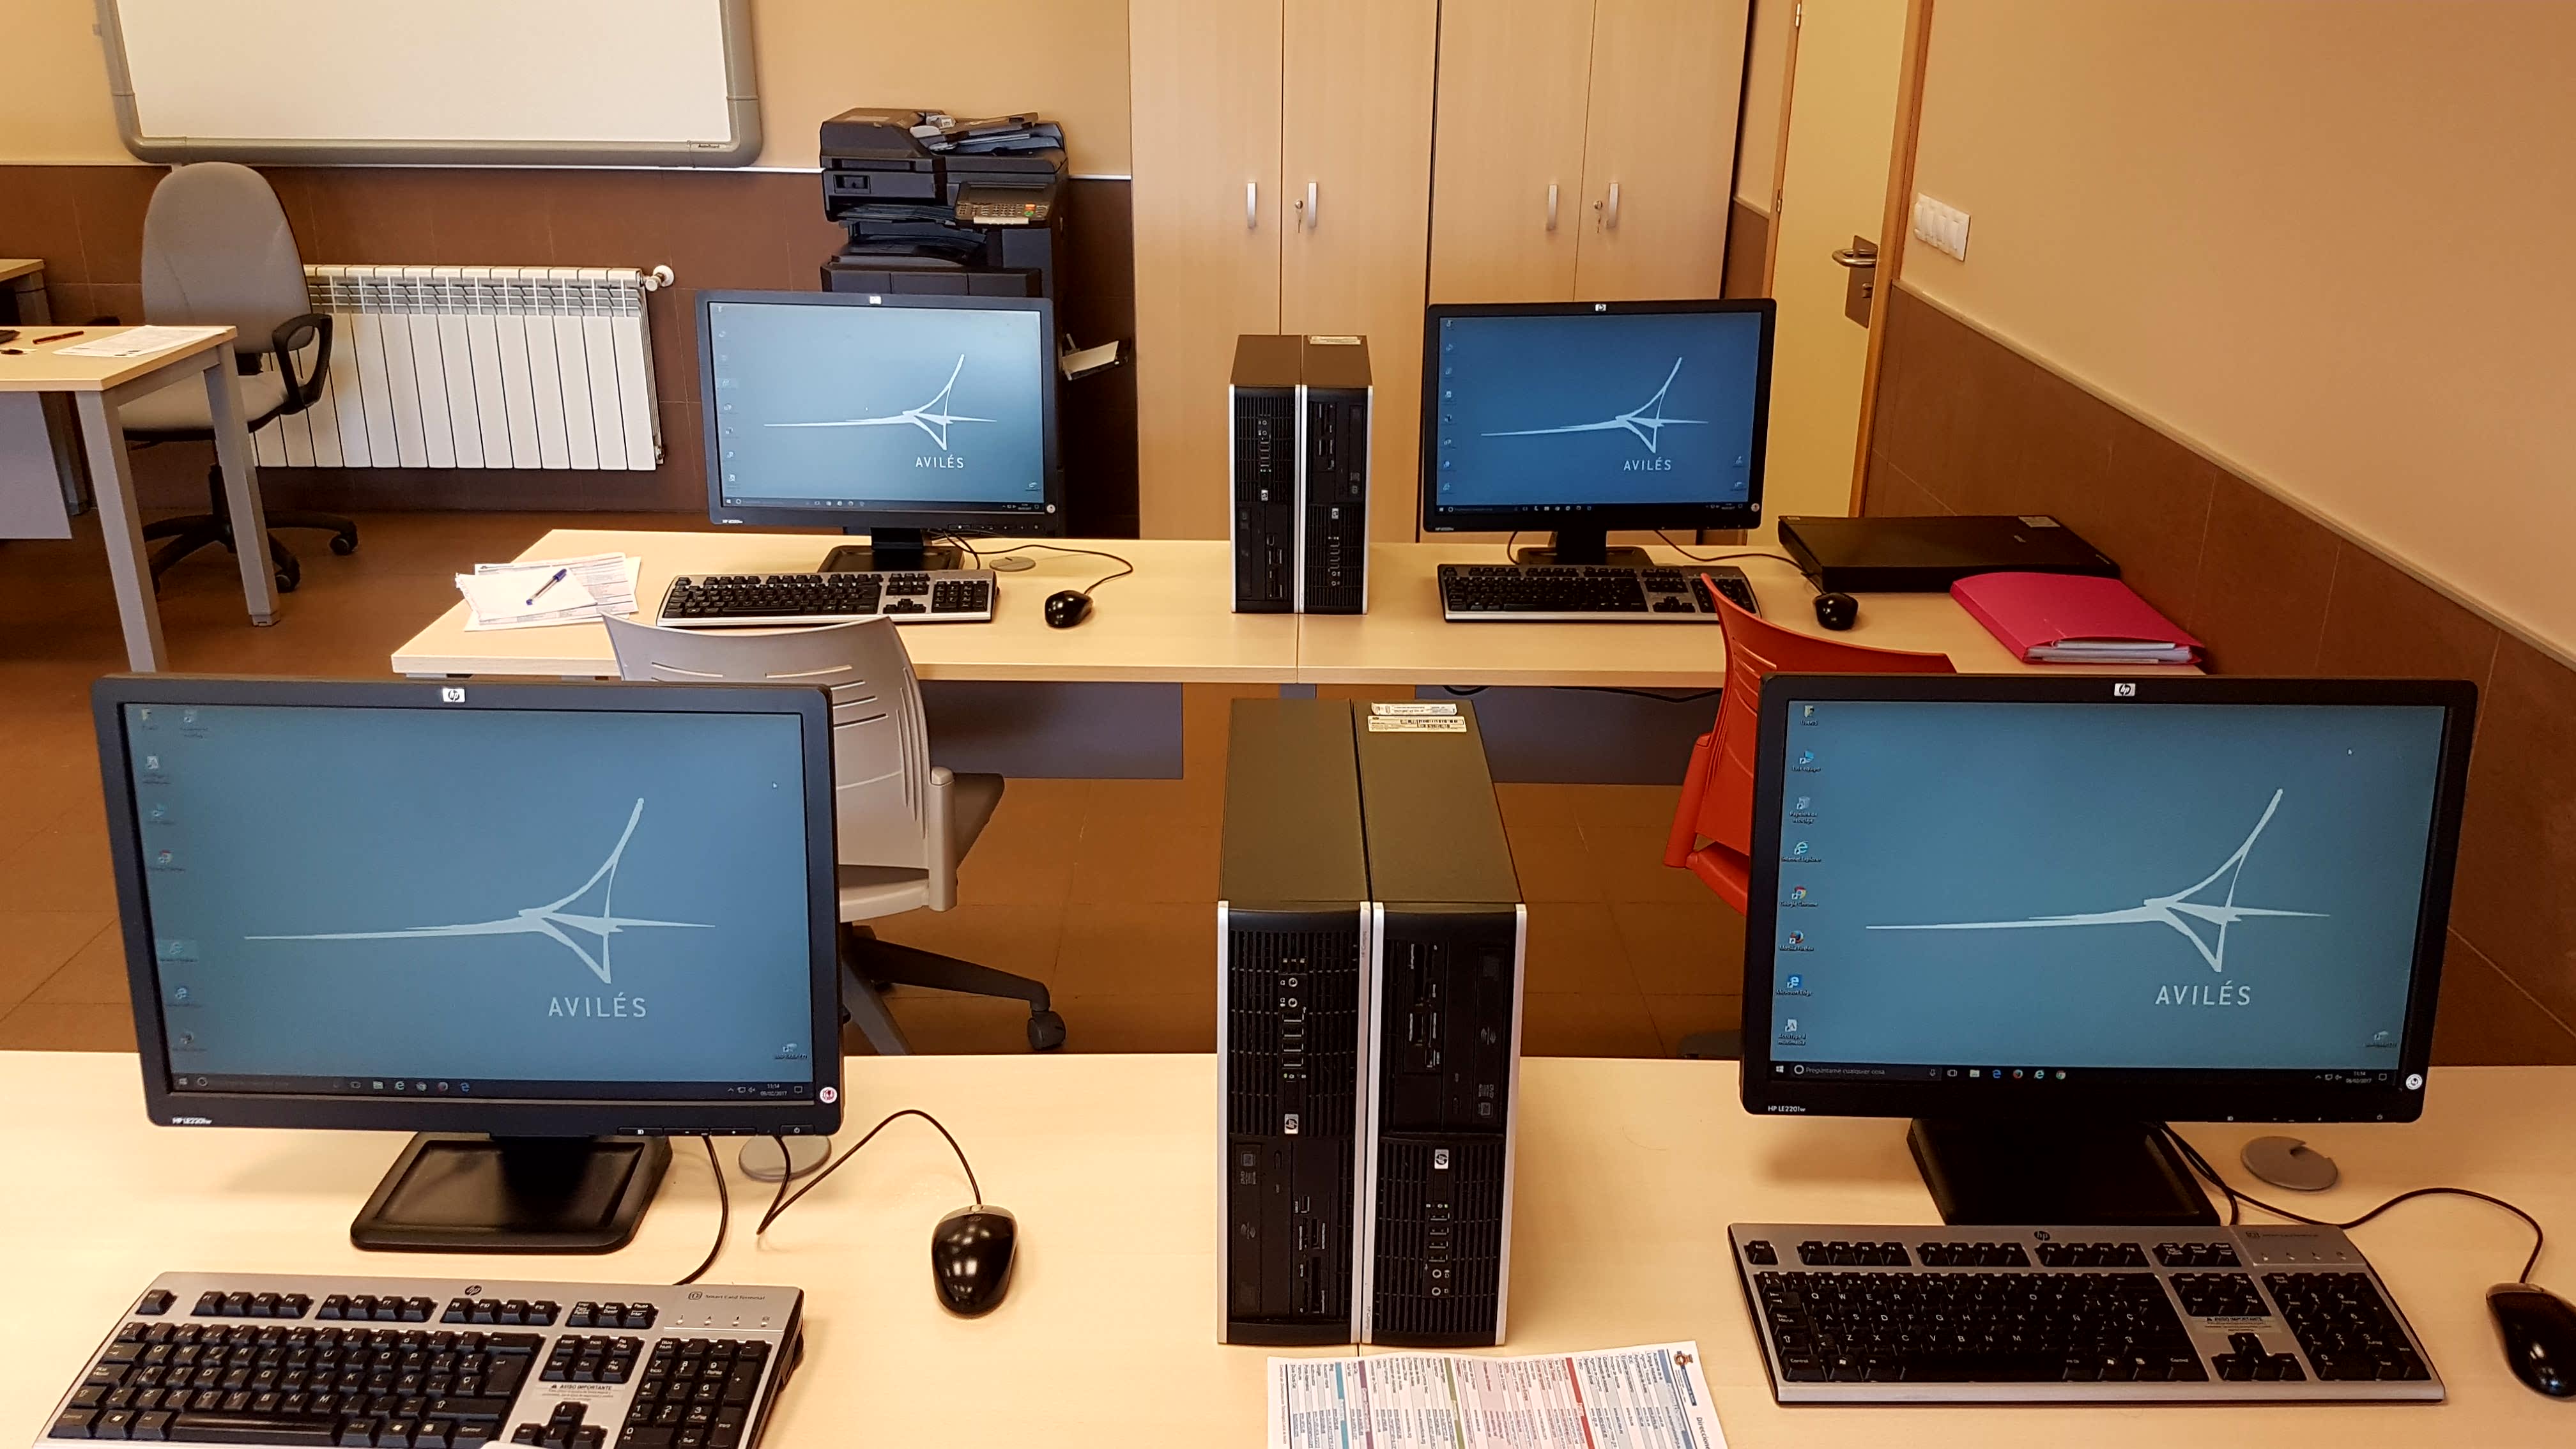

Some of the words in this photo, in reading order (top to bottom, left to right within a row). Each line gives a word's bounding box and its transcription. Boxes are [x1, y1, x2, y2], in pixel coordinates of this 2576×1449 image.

[916, 454, 964, 468] AVILÉS
[1623, 456, 1671, 471] AVILÉS
[2155, 980, 2251, 1006] AVILÉS
[548, 992, 646, 1017] AVILÉS
